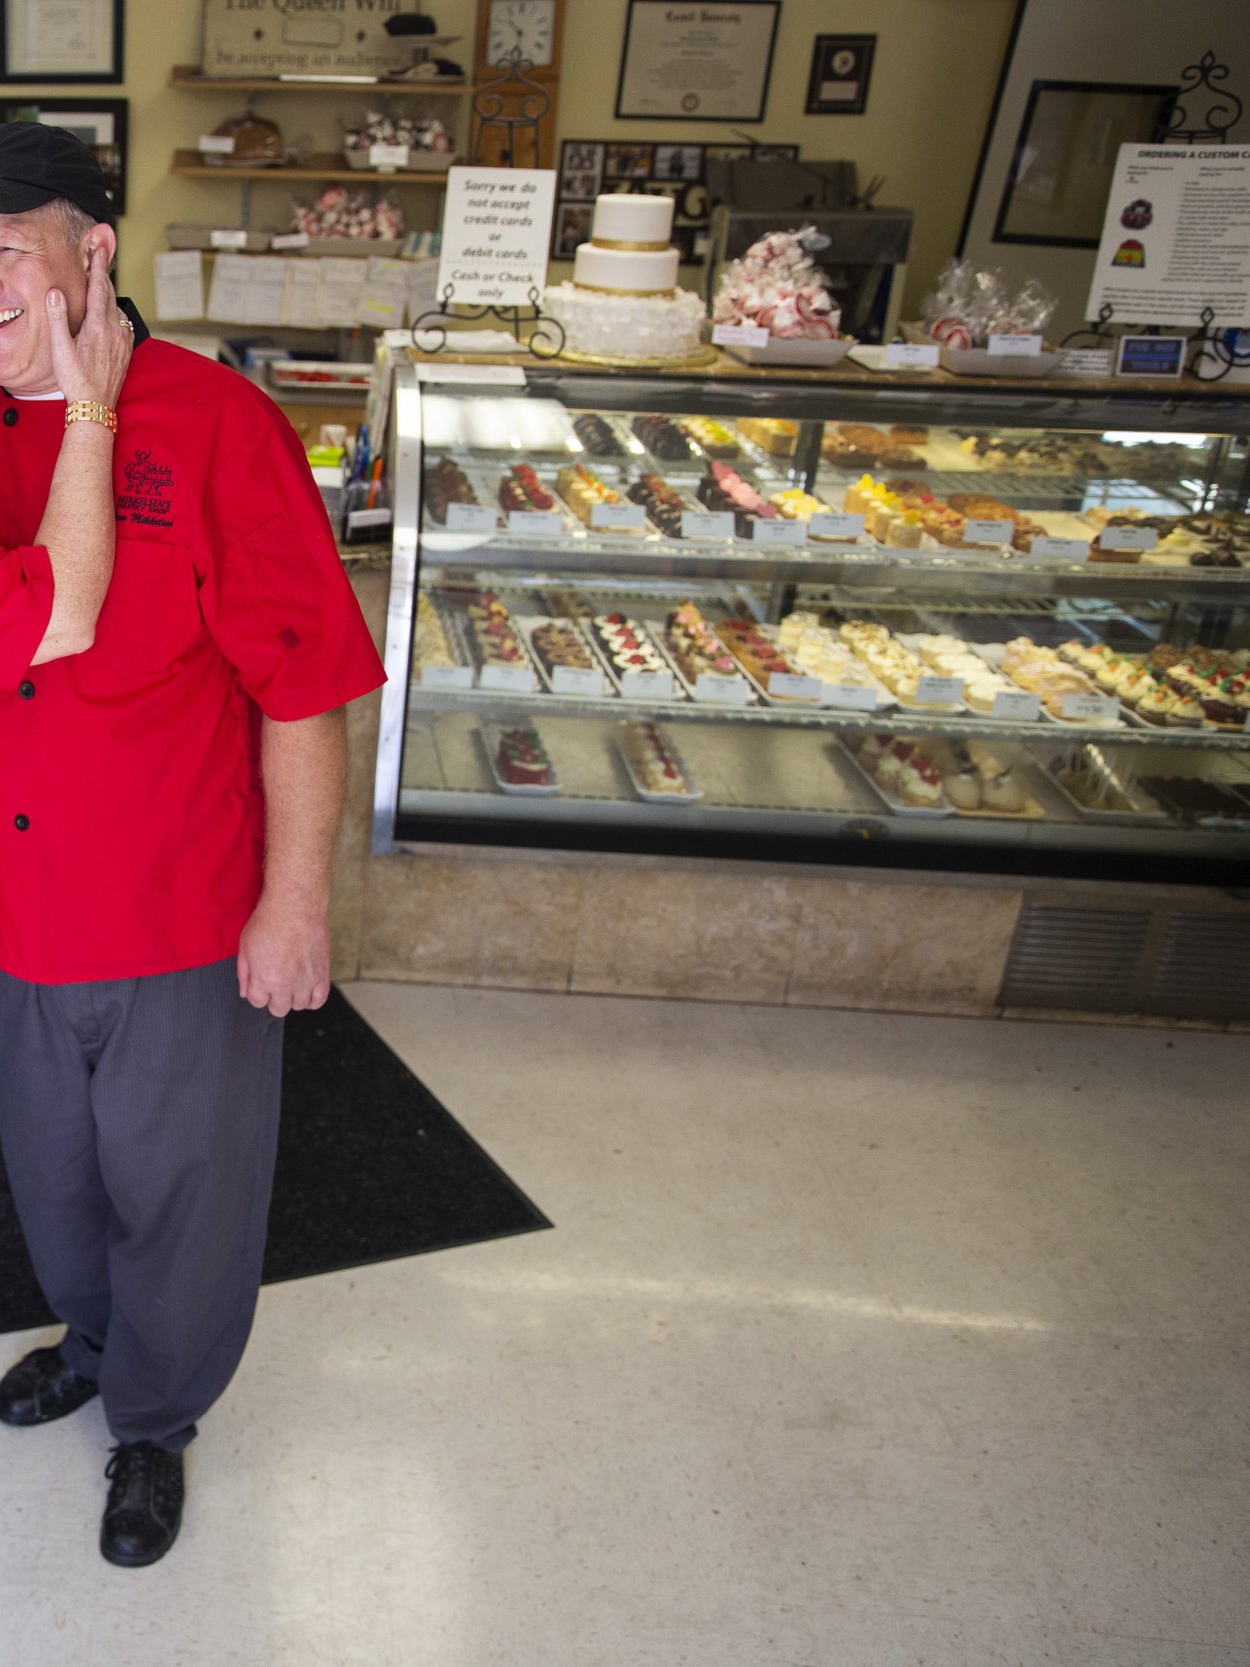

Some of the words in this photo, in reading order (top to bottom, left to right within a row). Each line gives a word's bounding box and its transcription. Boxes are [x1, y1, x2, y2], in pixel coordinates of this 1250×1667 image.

[273, 0, 345, 16] Queen
[1137, 151, 1187, 159] ORDERING
[1198, 151, 1240, 159] CUSTOM
[464, 180, 496, 193] Sorry
[499, 184, 517, 192] we
[521, 182, 537, 193] do
[467, 200, 488, 209] not
[491, 200, 530, 211] accept
[463, 216, 498, 225] credit
[501, 217, 533, 226] cards
[488, 233, 502, 241] or
[462, 247, 493, 258] debit
[495, 249, 528, 259] cards
[452, 269, 480, 281] Cash
[483, 272, 495, 281] or
[498, 270, 534, 282] Check
[478, 287, 504, 299] only
[117, 495, 172, 511] MIKKELSEN'S
